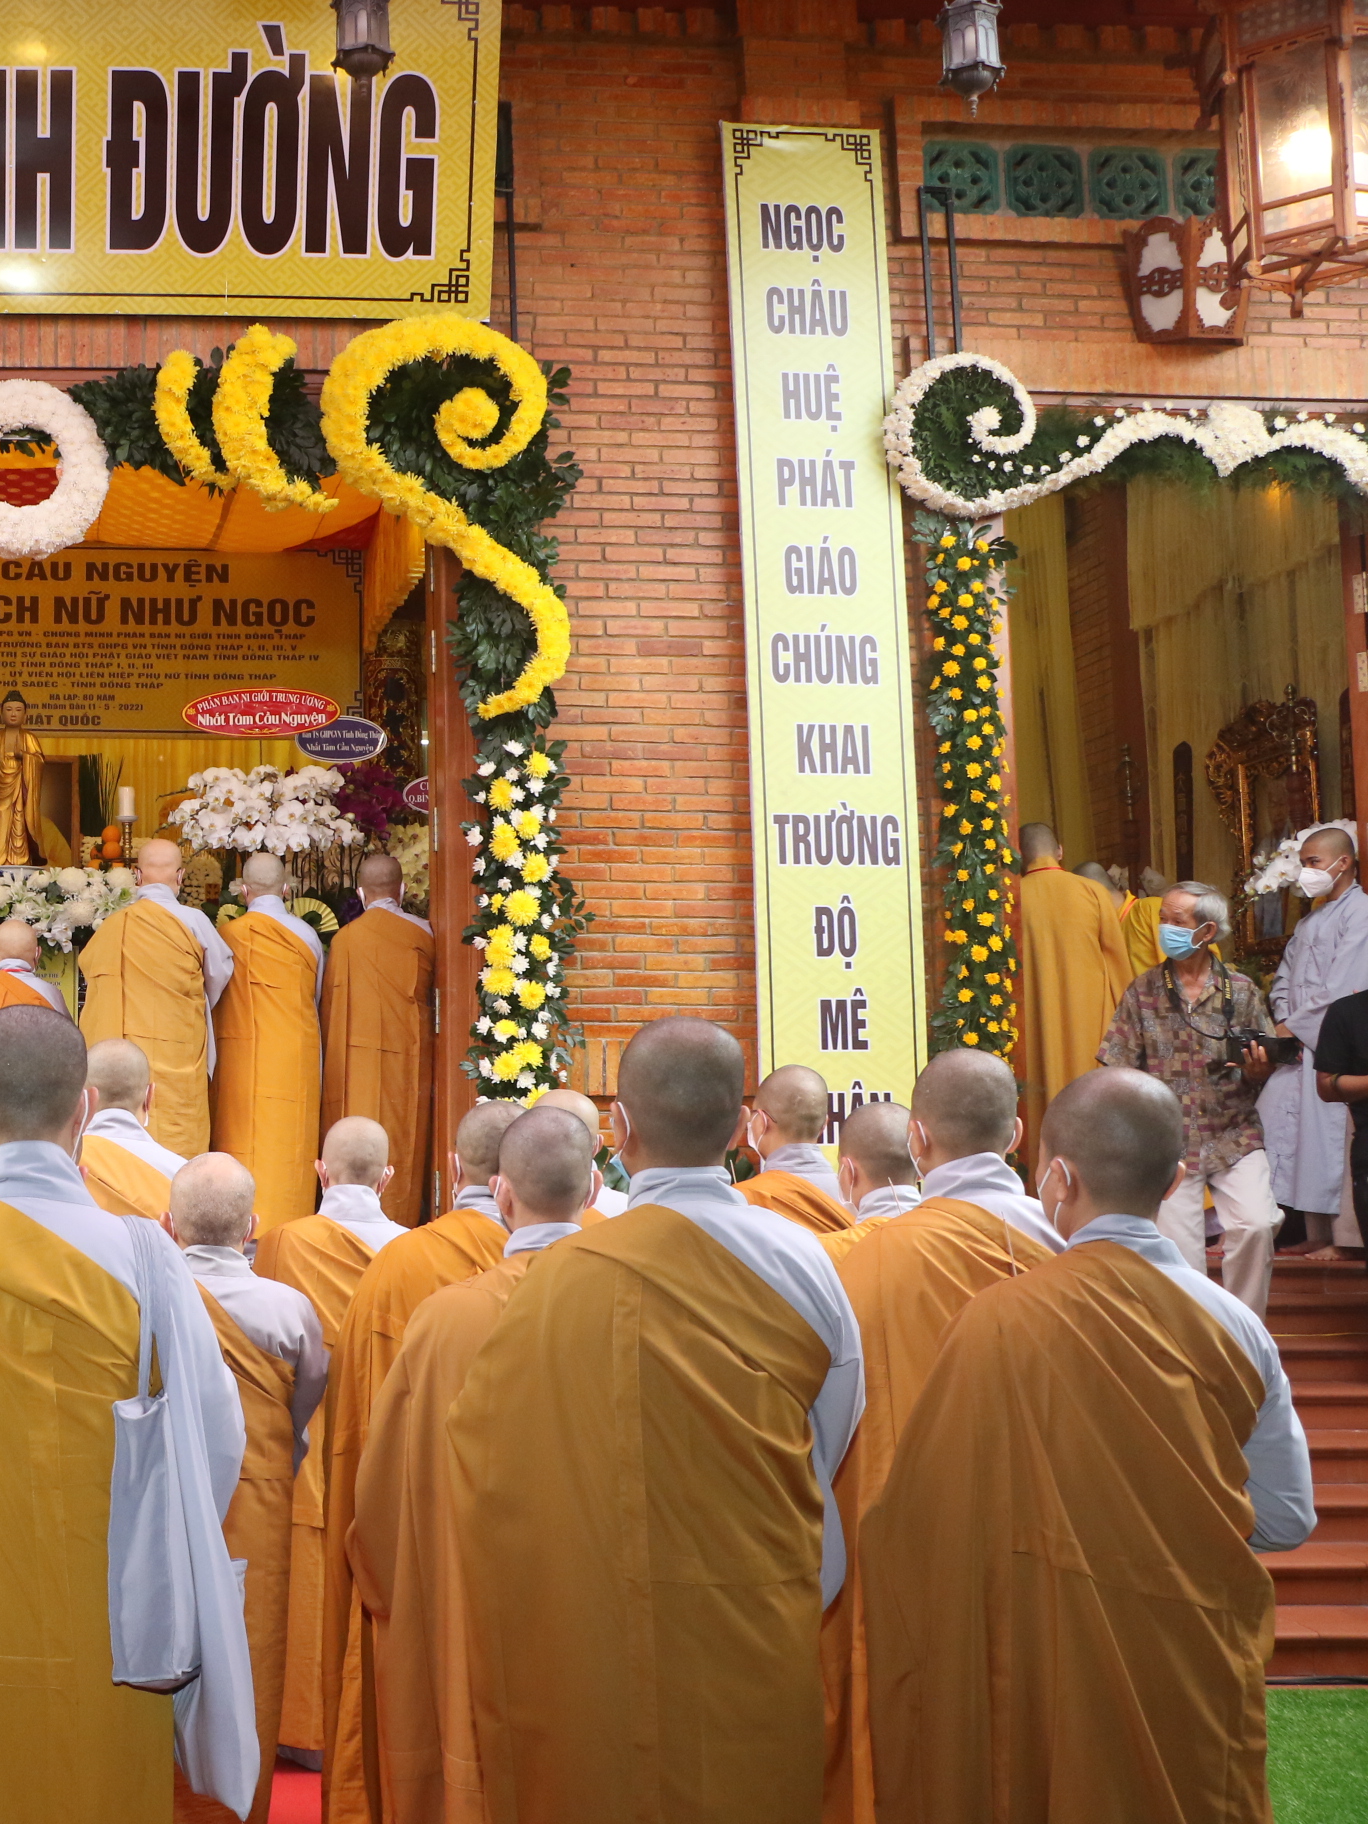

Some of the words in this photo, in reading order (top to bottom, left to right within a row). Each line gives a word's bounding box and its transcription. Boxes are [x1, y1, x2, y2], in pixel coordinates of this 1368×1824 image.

[105, 21, 440, 260] ĐƯỜNG
[759, 203, 845, 263] NGỌC
[766, 279, 849, 337] CHÂU
[781, 364, 843, 432] HUỆ
[775, 449, 856, 508] PHÁT
[85, 559, 229, 587] NGUYỆN
[783, 536, 858, 596] GIÁO
[54, 591, 110, 625] NỮ
[120, 595, 203, 627] NHƯ
[212, 598, 315, 632] NGỌC
[770, 623, 880, 685] CHÚNG
[58, 712, 101, 726] QUỐC
[198, 697, 221, 712] PHÂN
[222, 694, 240, 705] BAN
[241, 692, 250, 703] NI
[252, 690, 270, 702] GIỚI
[272, 694, 300, 704] TRUNG
[301, 696, 326, 711] ƯƠNG
[198, 712, 226, 726] Nhất
[228, 712, 254, 726] Tâm
[256, 710, 280, 726] Cầu
[280, 712, 326, 728] Nguyện
[796, 723, 872, 775] KHAI
[773, 802, 902, 866] TRƯỜNG
[814, 895, 857, 970] ĐỘ
[819, 988, 869, 1051] MÊ
